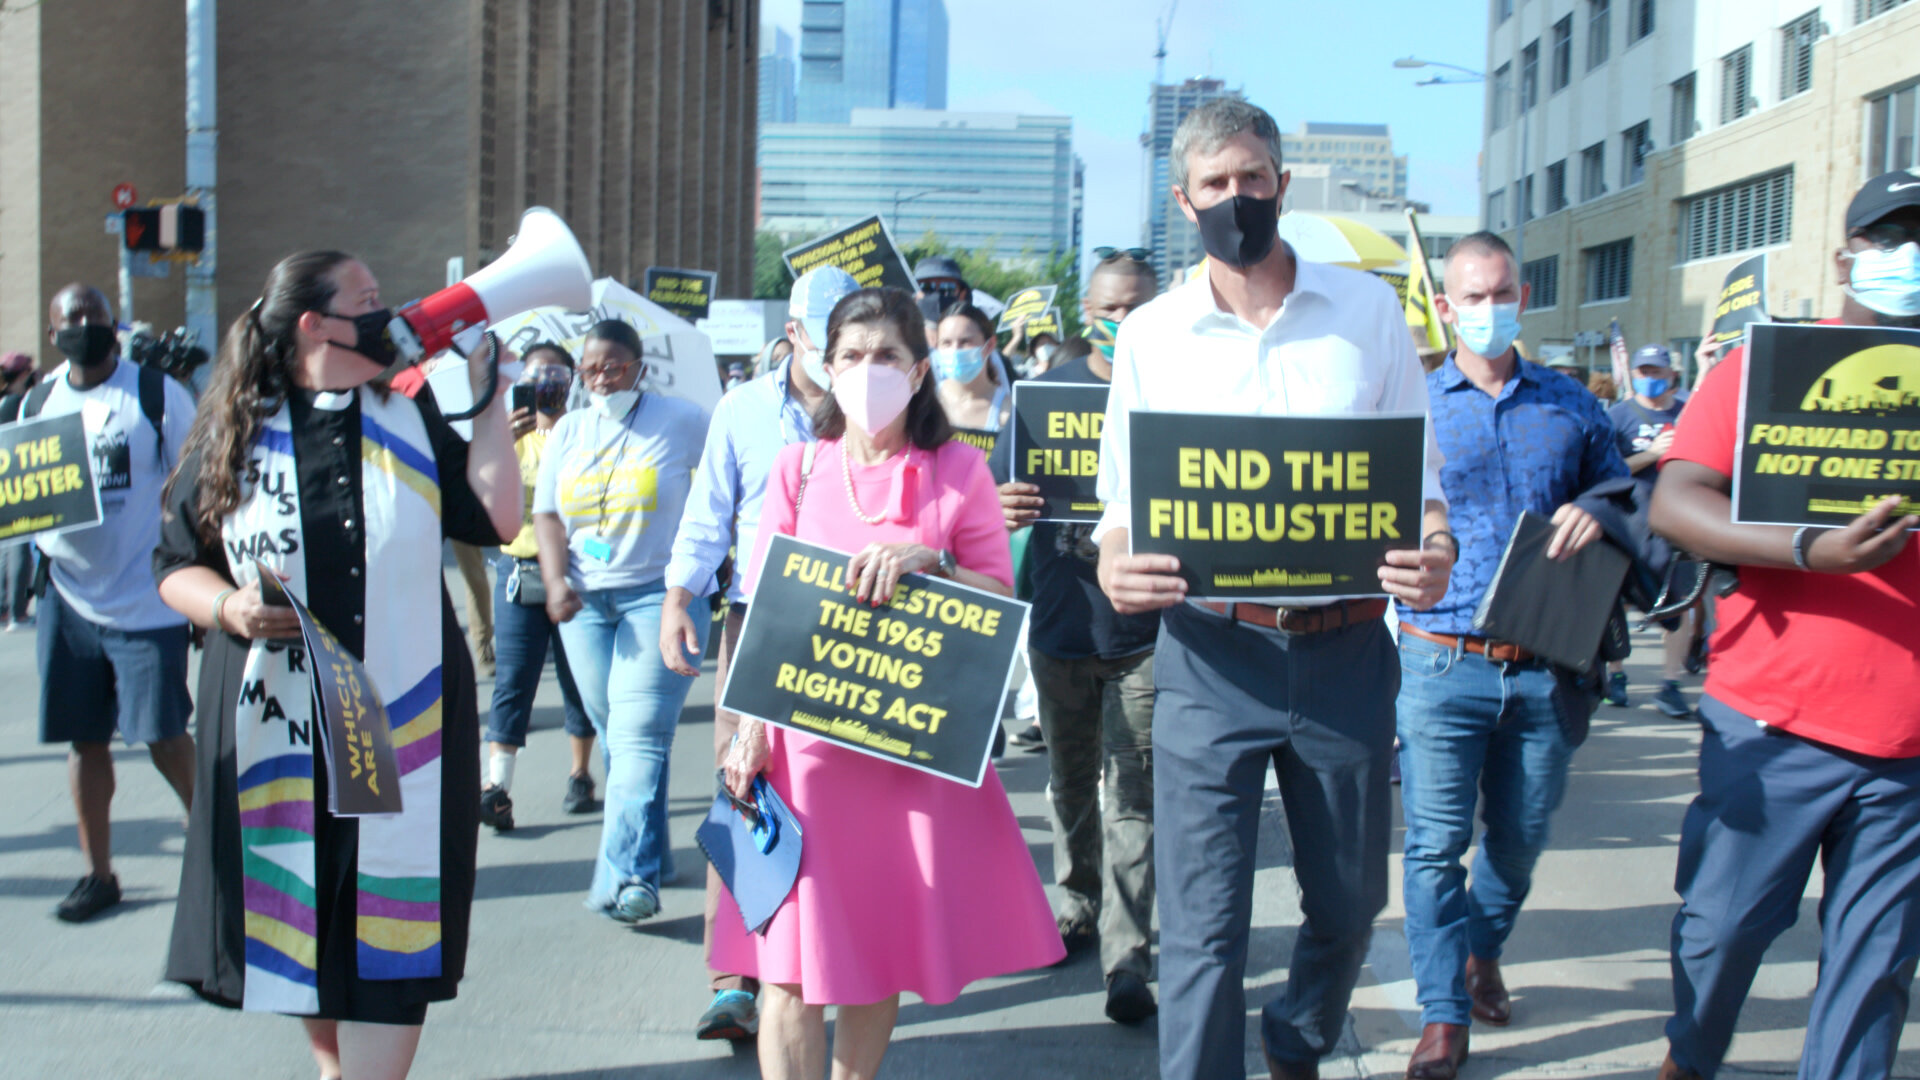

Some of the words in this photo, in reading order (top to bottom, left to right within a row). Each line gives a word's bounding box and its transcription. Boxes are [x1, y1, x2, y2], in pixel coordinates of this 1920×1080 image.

[14, 433, 63, 471] THE
[1748, 423, 1889, 451] FORWARD
[1178, 447, 1272, 491] END
[1283, 450, 1371, 492] THE
[1754, 453, 1821, 477] NOT
[1819, 456, 1885, 480] ONE
[227, 527, 299, 565] WAS
[1149, 498, 1402, 543] FILIBUSTER
[782, 552, 864, 597] FULL
[879, 583, 1002, 637] ESTORE
[818, 599, 873, 638] THE
[876, 617, 945, 658] 1965
[811, 634, 924, 690] VOTING
[239, 678, 311, 746] MAN
[331, 662, 363, 780] WHICH
[775, 662, 883, 717] RIGHTS
[882, 696, 948, 735] ACT
[360, 731, 380, 797] ARE
